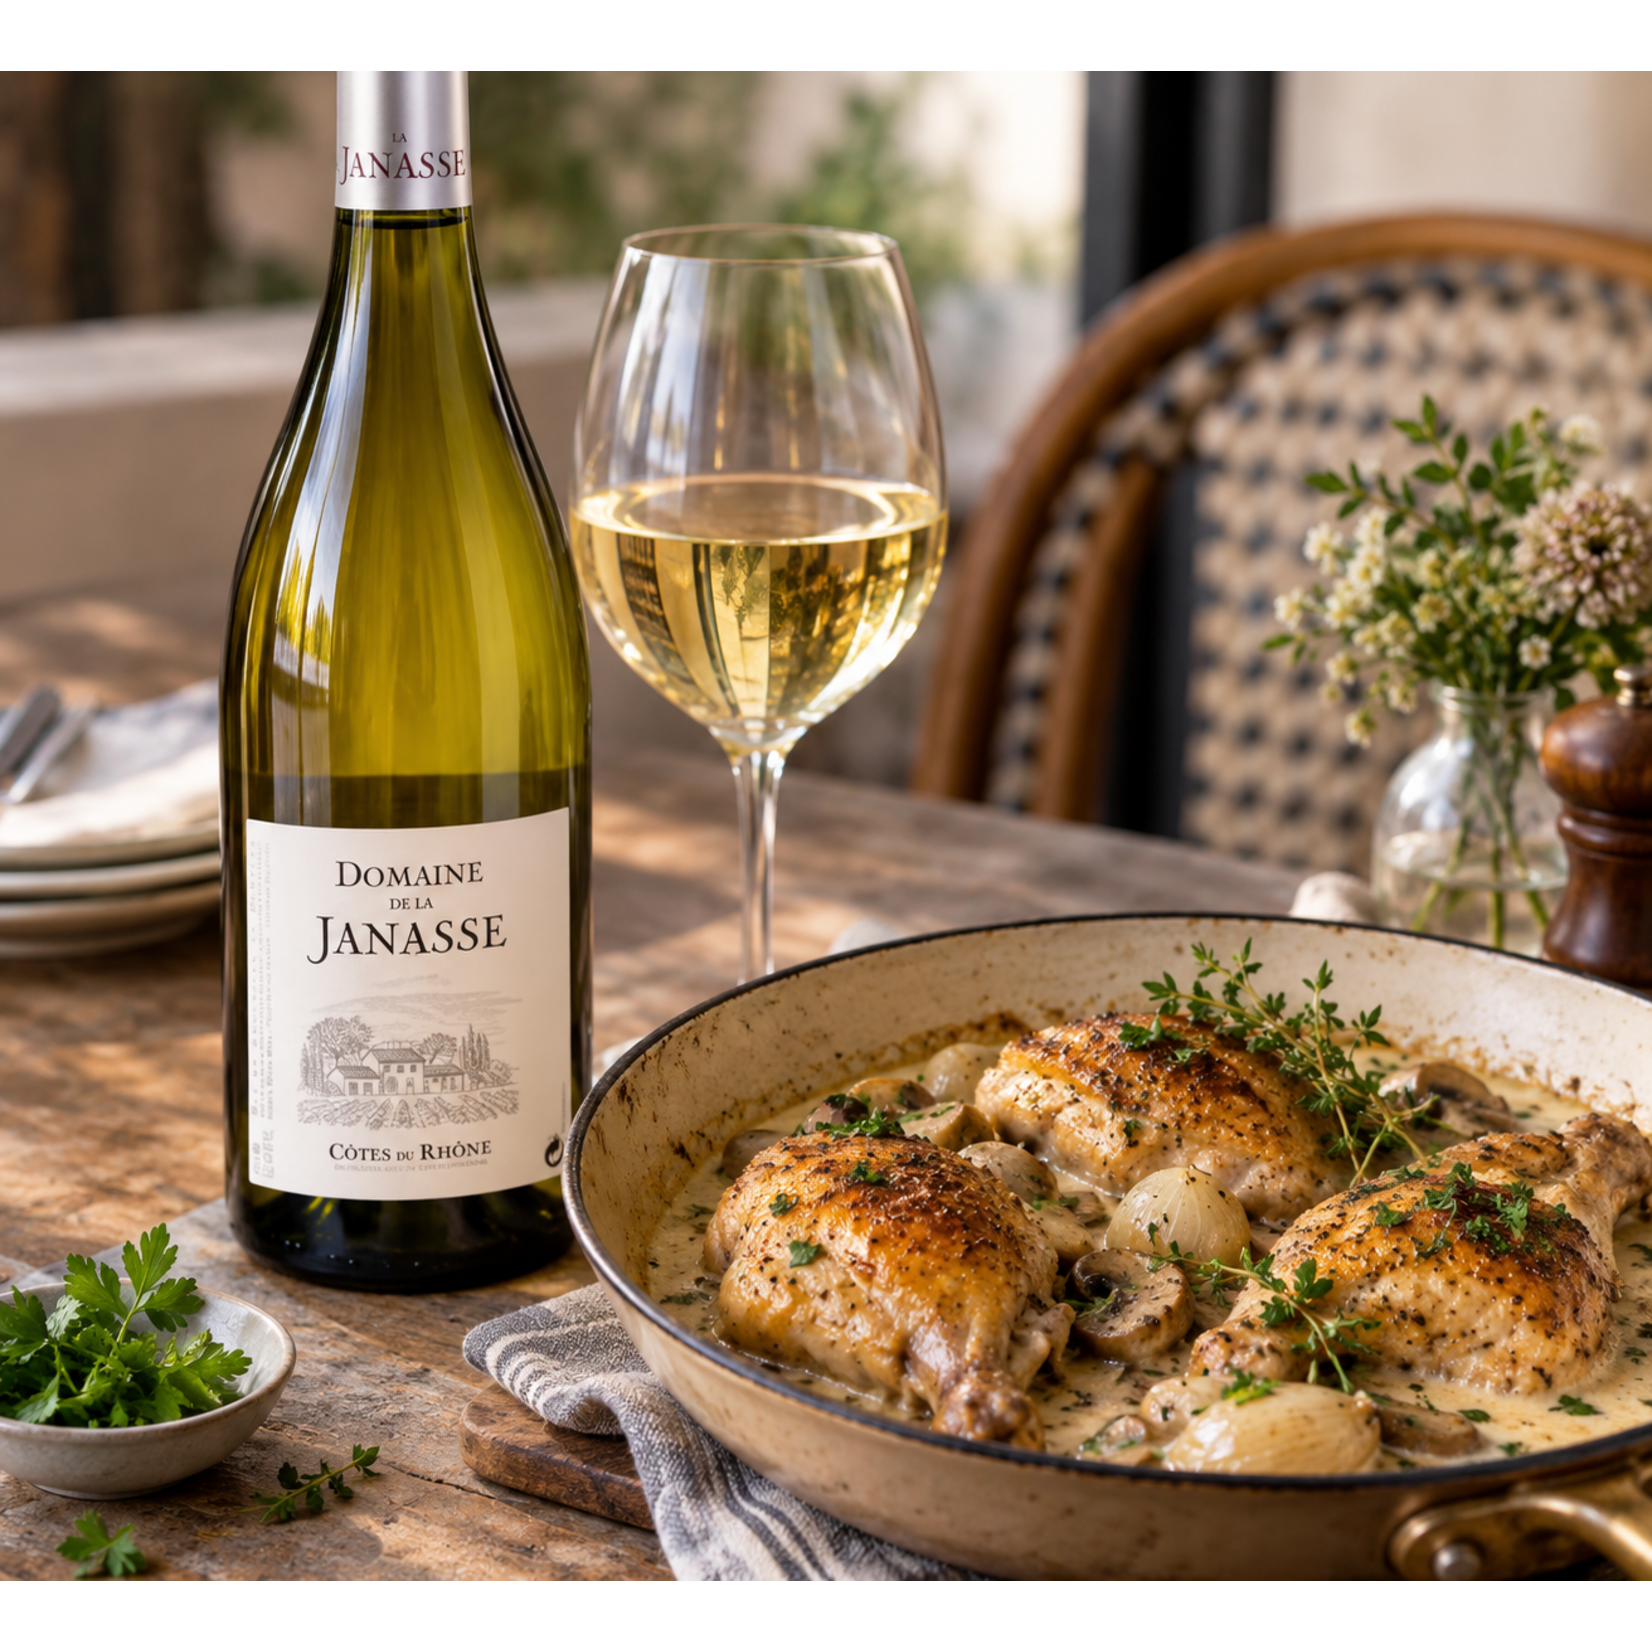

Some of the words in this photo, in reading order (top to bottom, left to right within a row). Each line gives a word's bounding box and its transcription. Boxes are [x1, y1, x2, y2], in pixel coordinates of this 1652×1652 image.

[392, 132, 407, 143] LA
[339, 146, 466, 185] JANASSE
[335, 860, 484, 887] DOMAINE
[389, 897, 412, 911] DE
[414, 896, 434, 910] LA
[306, 914, 508, 964] JANASSE
[396, 1150, 415, 1162] DU
